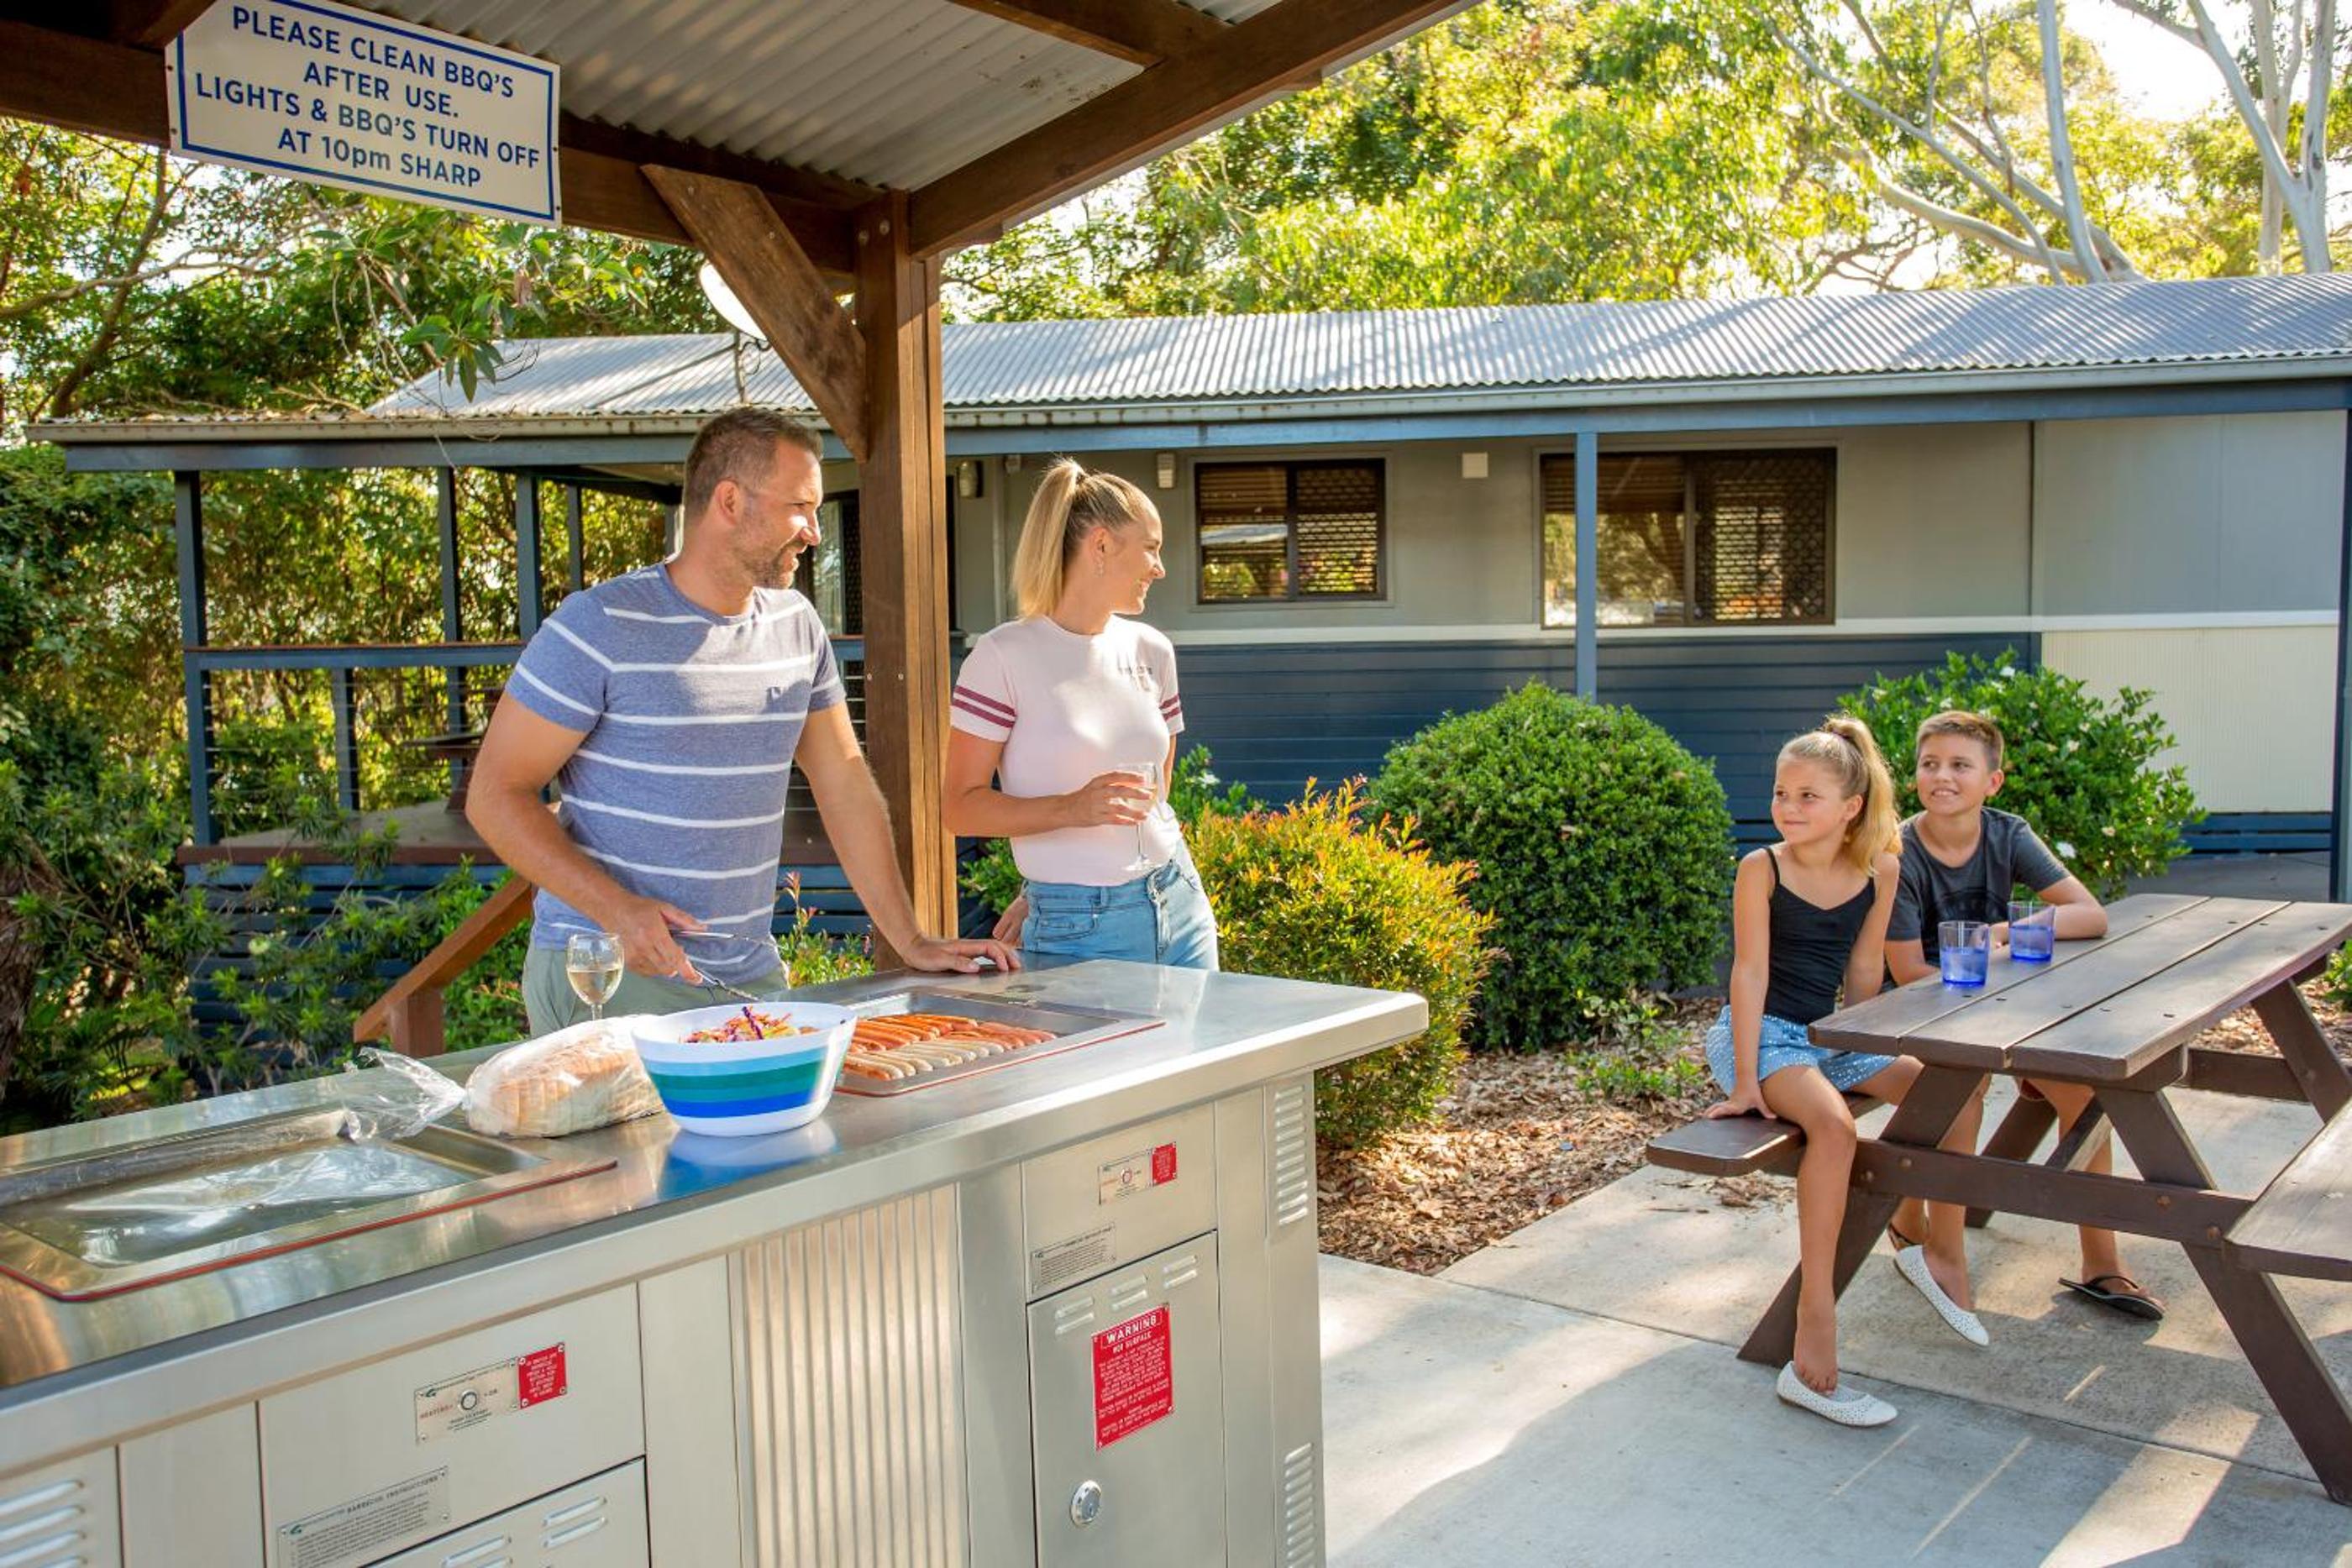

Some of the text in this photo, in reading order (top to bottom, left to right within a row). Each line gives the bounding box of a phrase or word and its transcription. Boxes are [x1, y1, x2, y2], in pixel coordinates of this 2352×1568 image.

[233, 6, 513, 97] PLEASE CLEAN BBQ'S
[196, 72, 539, 167] LIGHTS & BBQ'S TURN OFF
[303, 62, 459, 118] AFTER USE.
[277, 128, 481, 187] AT 10pm SHARP
[1106, 1314, 1157, 1344] WARNING
